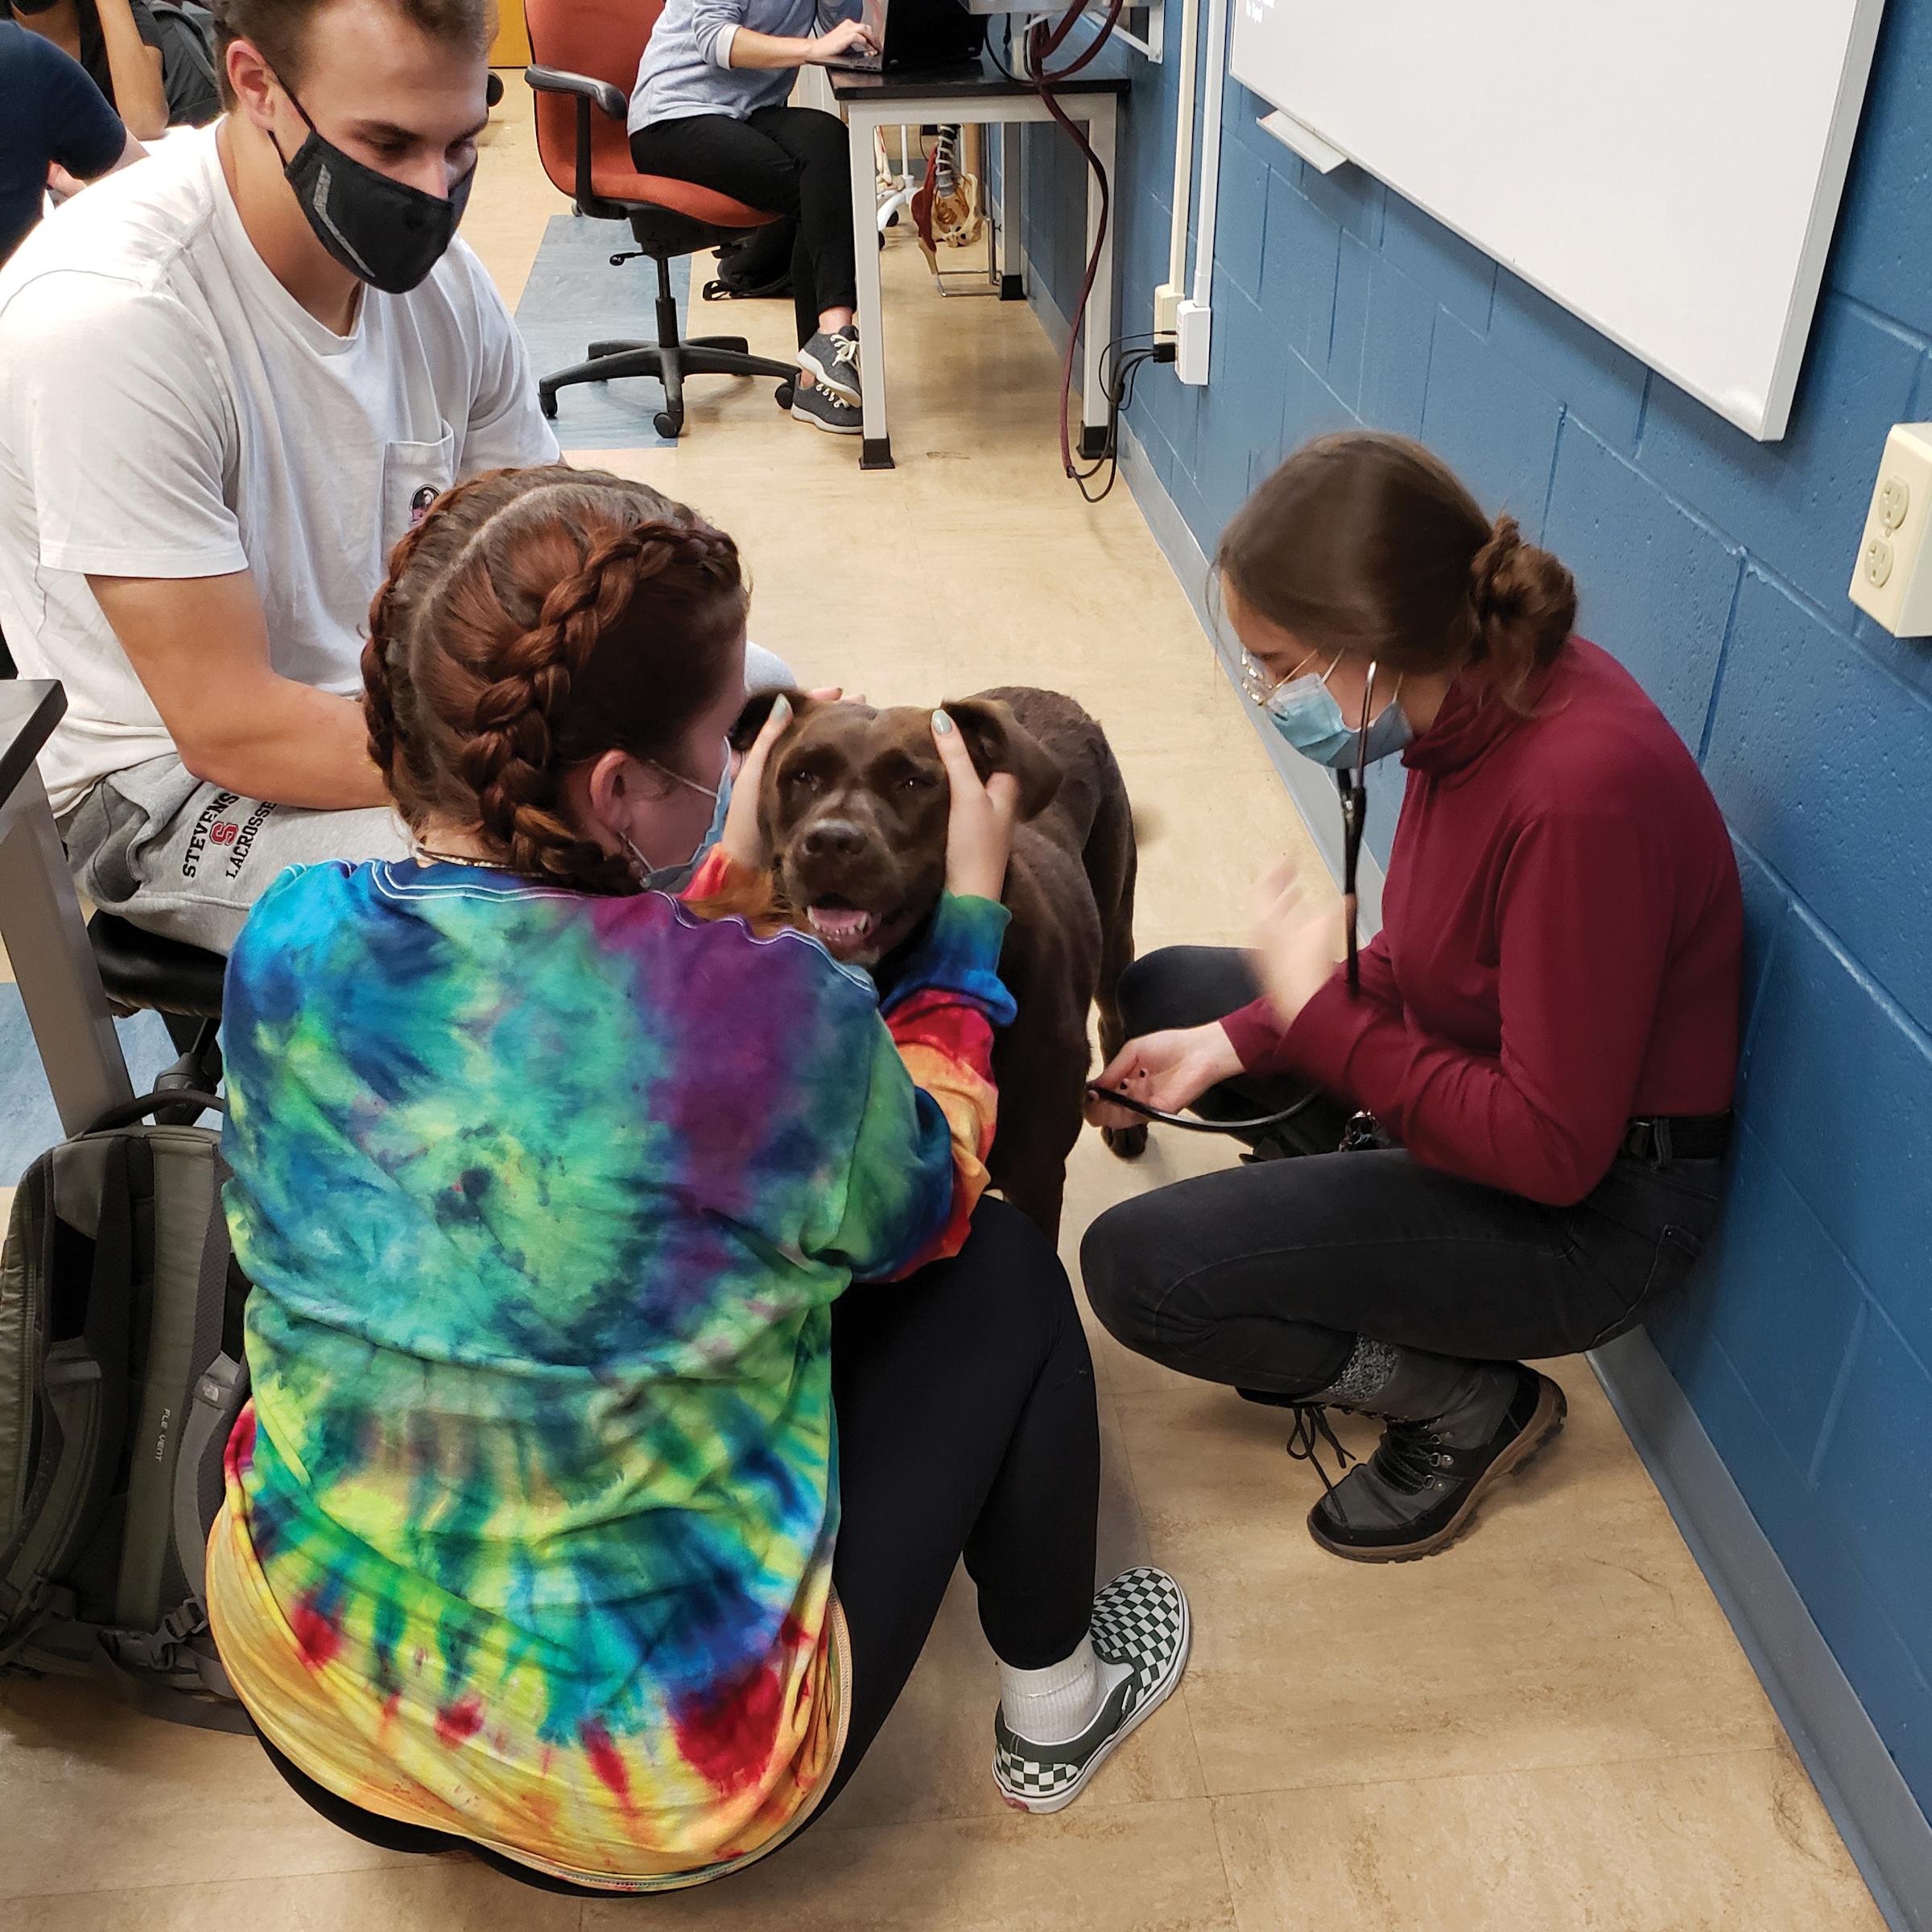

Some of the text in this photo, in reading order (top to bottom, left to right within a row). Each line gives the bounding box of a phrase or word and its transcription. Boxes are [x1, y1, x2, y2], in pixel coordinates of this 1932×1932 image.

[183, 792, 240, 878] STEVENS
[209, 821, 239, 846] S
[225, 801, 278, 879] LACROSSE
